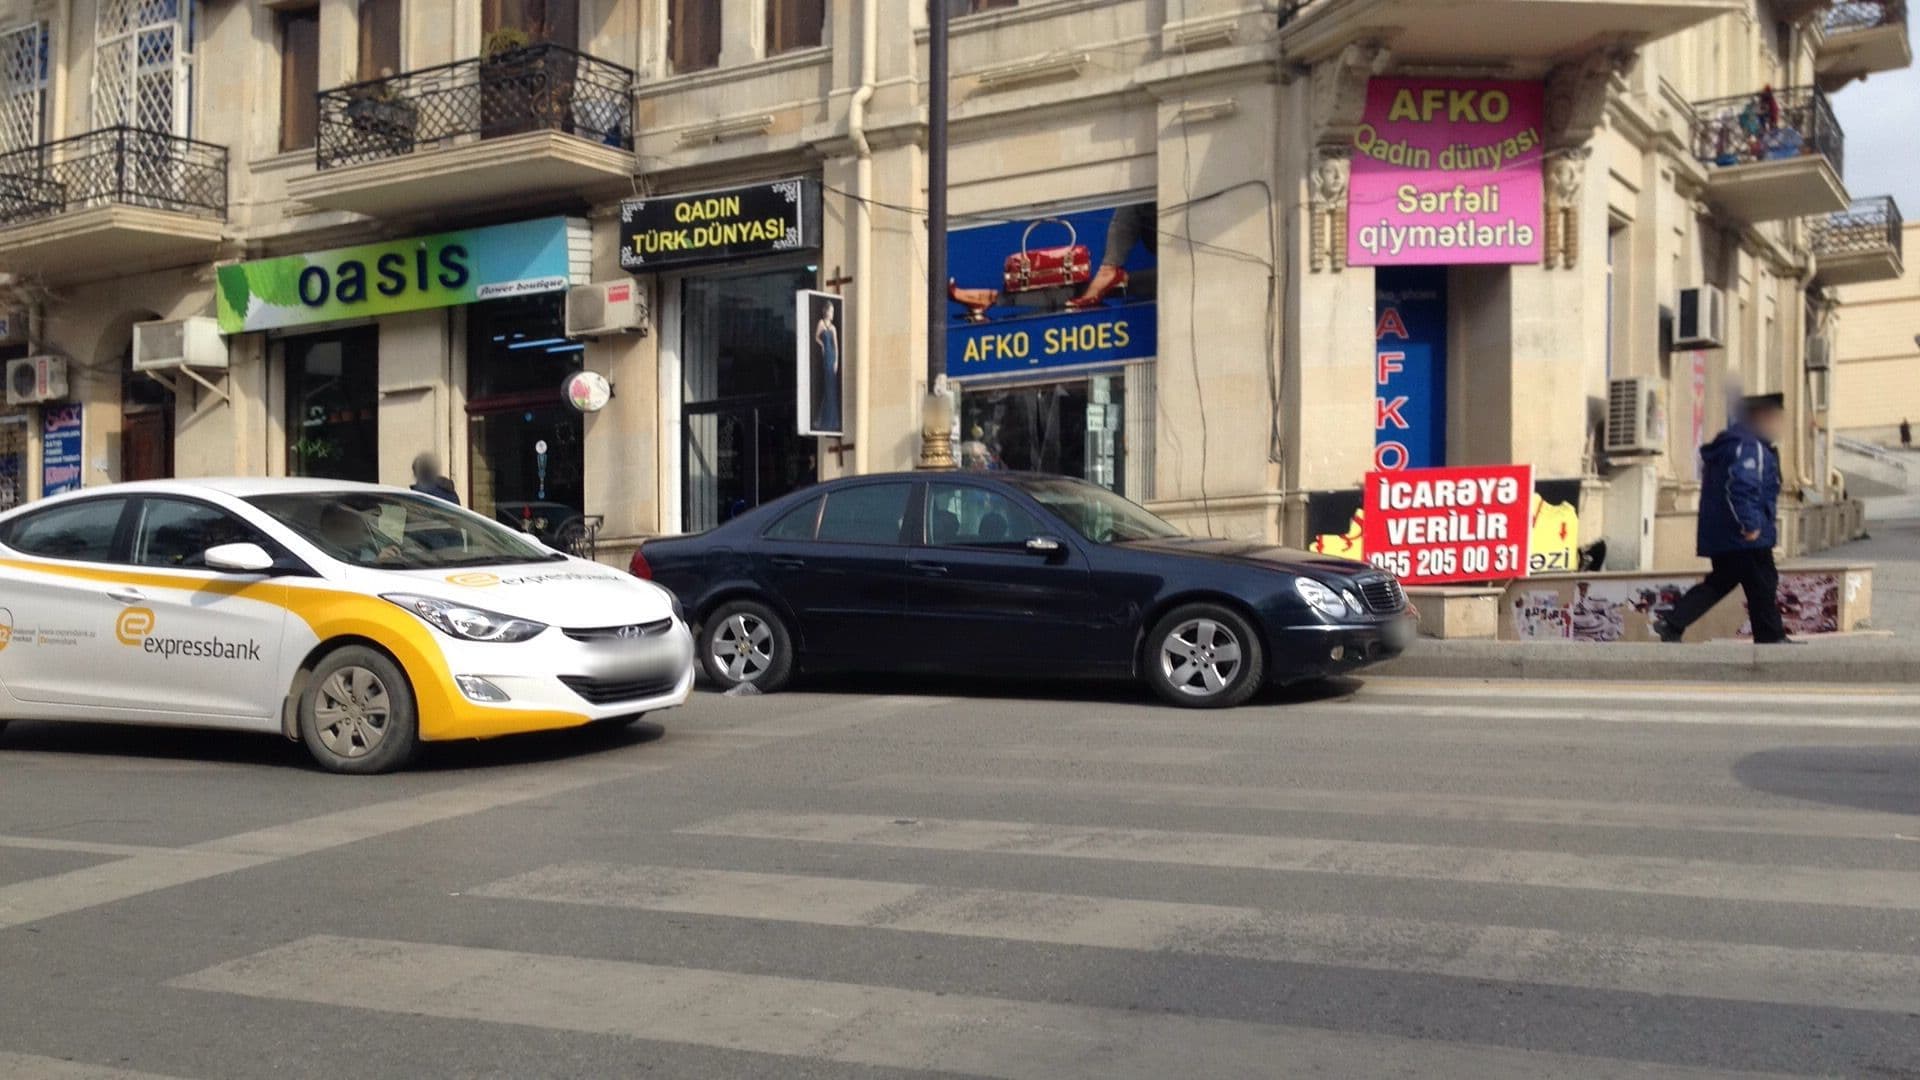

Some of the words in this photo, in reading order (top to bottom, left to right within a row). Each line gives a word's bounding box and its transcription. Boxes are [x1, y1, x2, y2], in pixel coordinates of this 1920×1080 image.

[1388, 88, 1510, 123] AFKO
[1353, 123, 1431, 169] Qadın
[1438, 127, 1540, 171] dünyası
[674, 195, 740, 224] QADIN
[1397, 184, 1499, 213] Sərfəli
[632, 229, 688, 254] TÜRK
[693, 217, 785, 247] DÜNYASI
[1358, 218, 1533, 256] qiymətlərlə
[298, 242, 470, 308] oasis
[480, 284, 514, 297] flower
[516, 278, 565, 293] boutique
[1044, 321, 1130, 354] SHOES
[1379, 477, 1518, 511] İCARƏYƏ
[1386, 508, 1509, 546] VERİLİR
[1416, 547, 1457, 576] 205
[1462, 546, 1489, 574] 00
[1494, 544, 1519, 572] 31
[144, 636, 261, 661] expressbank
